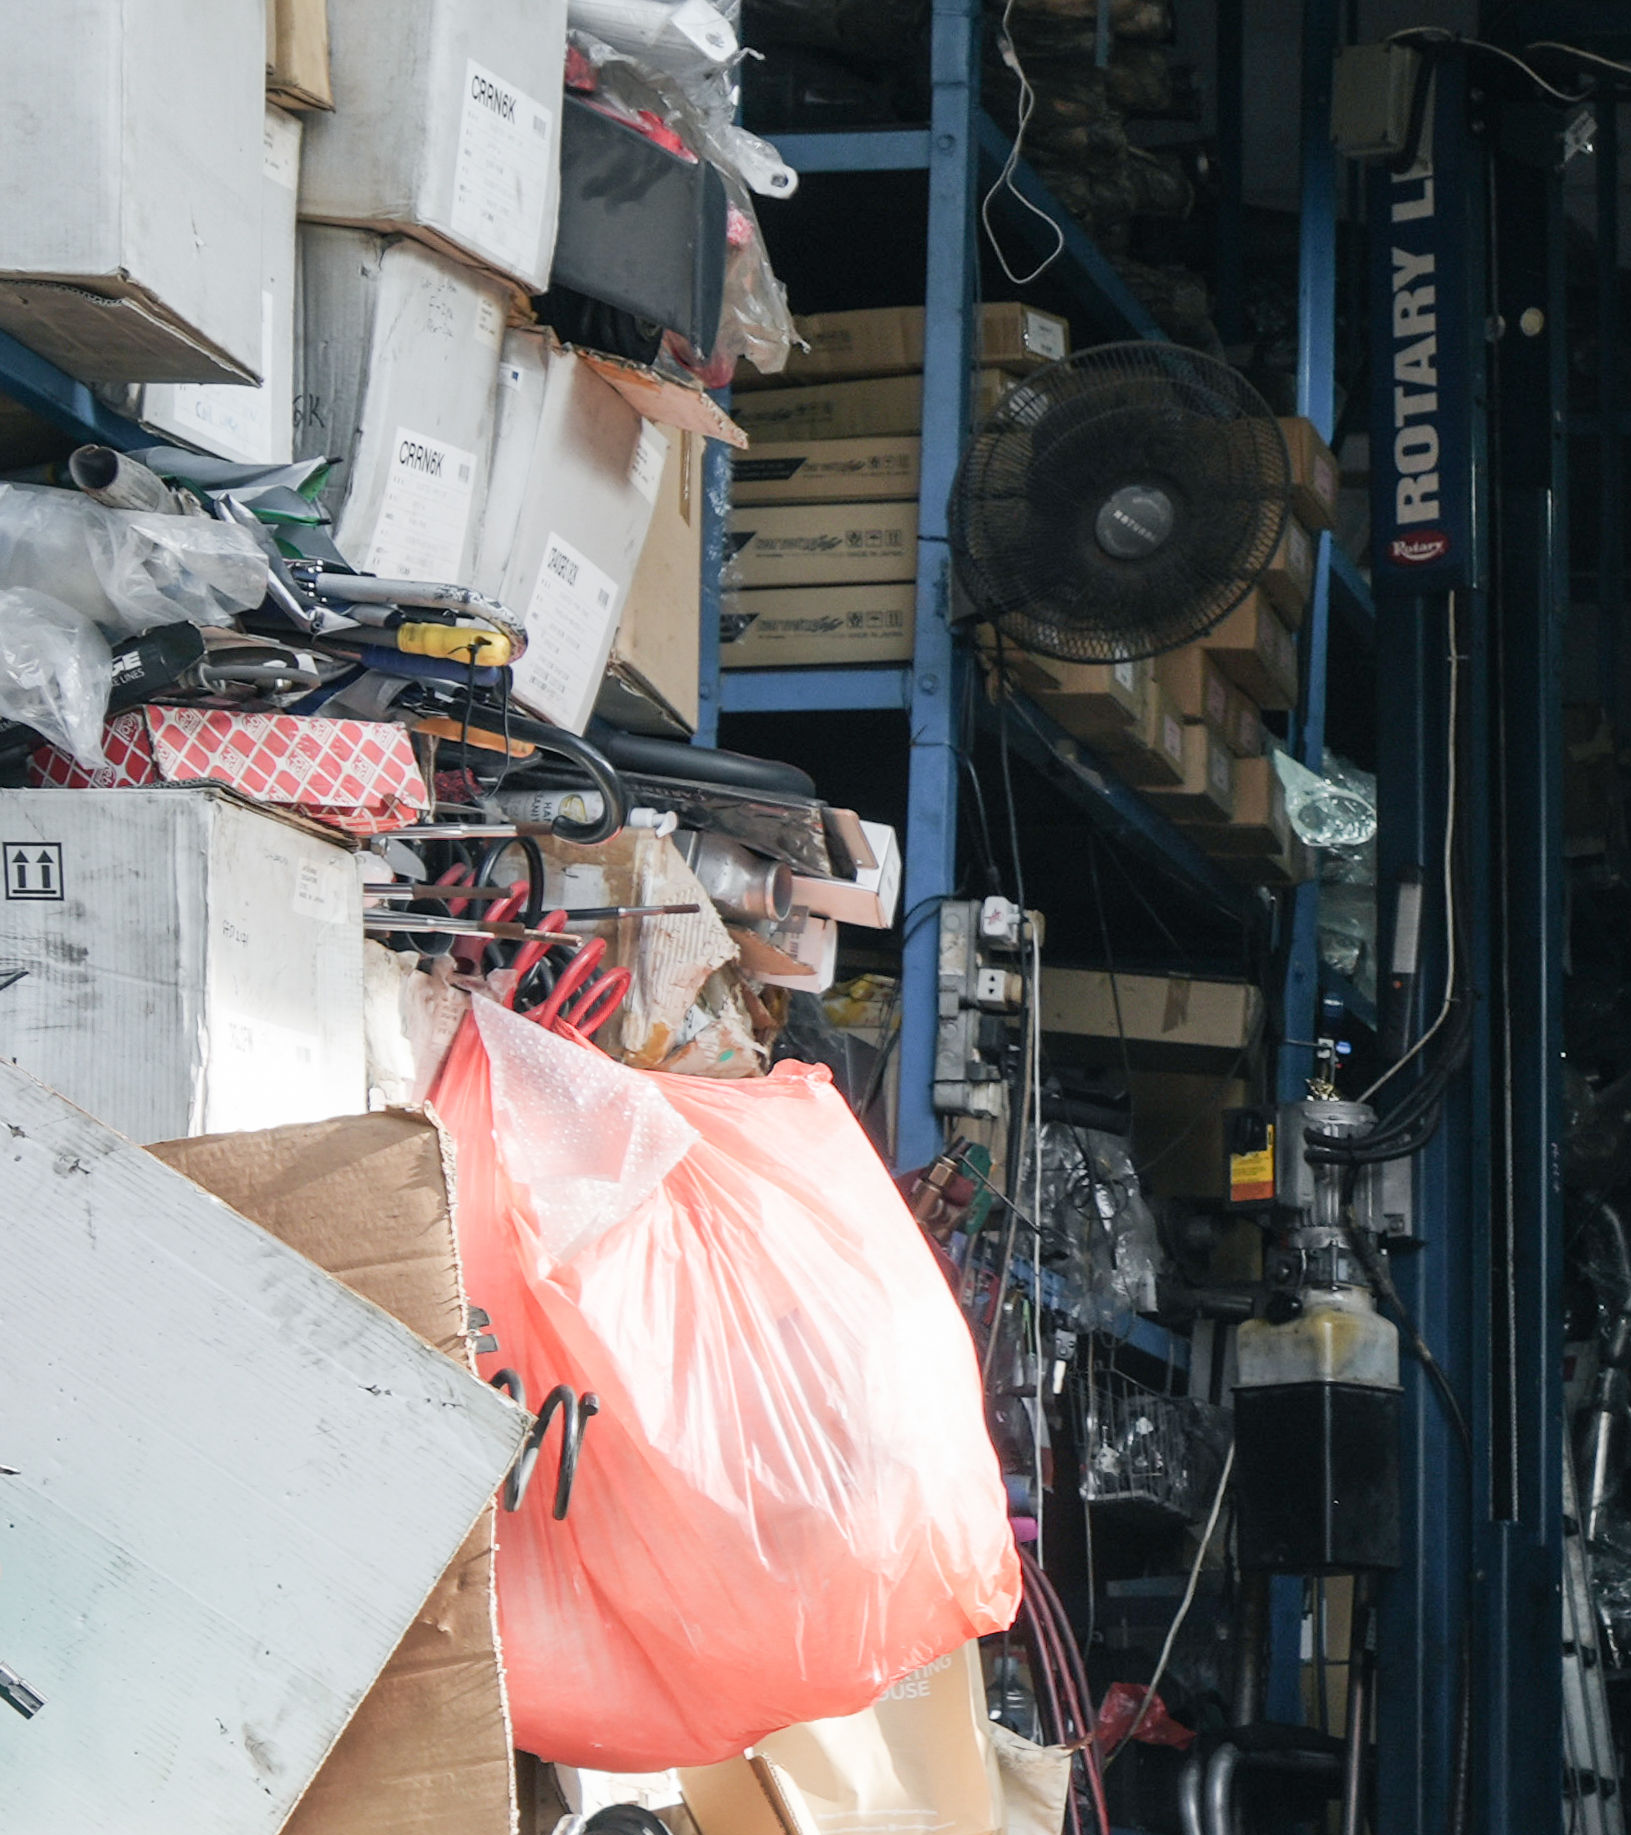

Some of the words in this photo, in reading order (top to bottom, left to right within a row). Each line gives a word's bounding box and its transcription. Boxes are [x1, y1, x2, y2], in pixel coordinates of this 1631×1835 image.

[470, 75, 518, 125] CRRN6K
[1392, 242, 1442, 527] ROTARY
[398, 440, 445, 478] CRRN6K
[1391, 540, 1444, 561] Rotary
